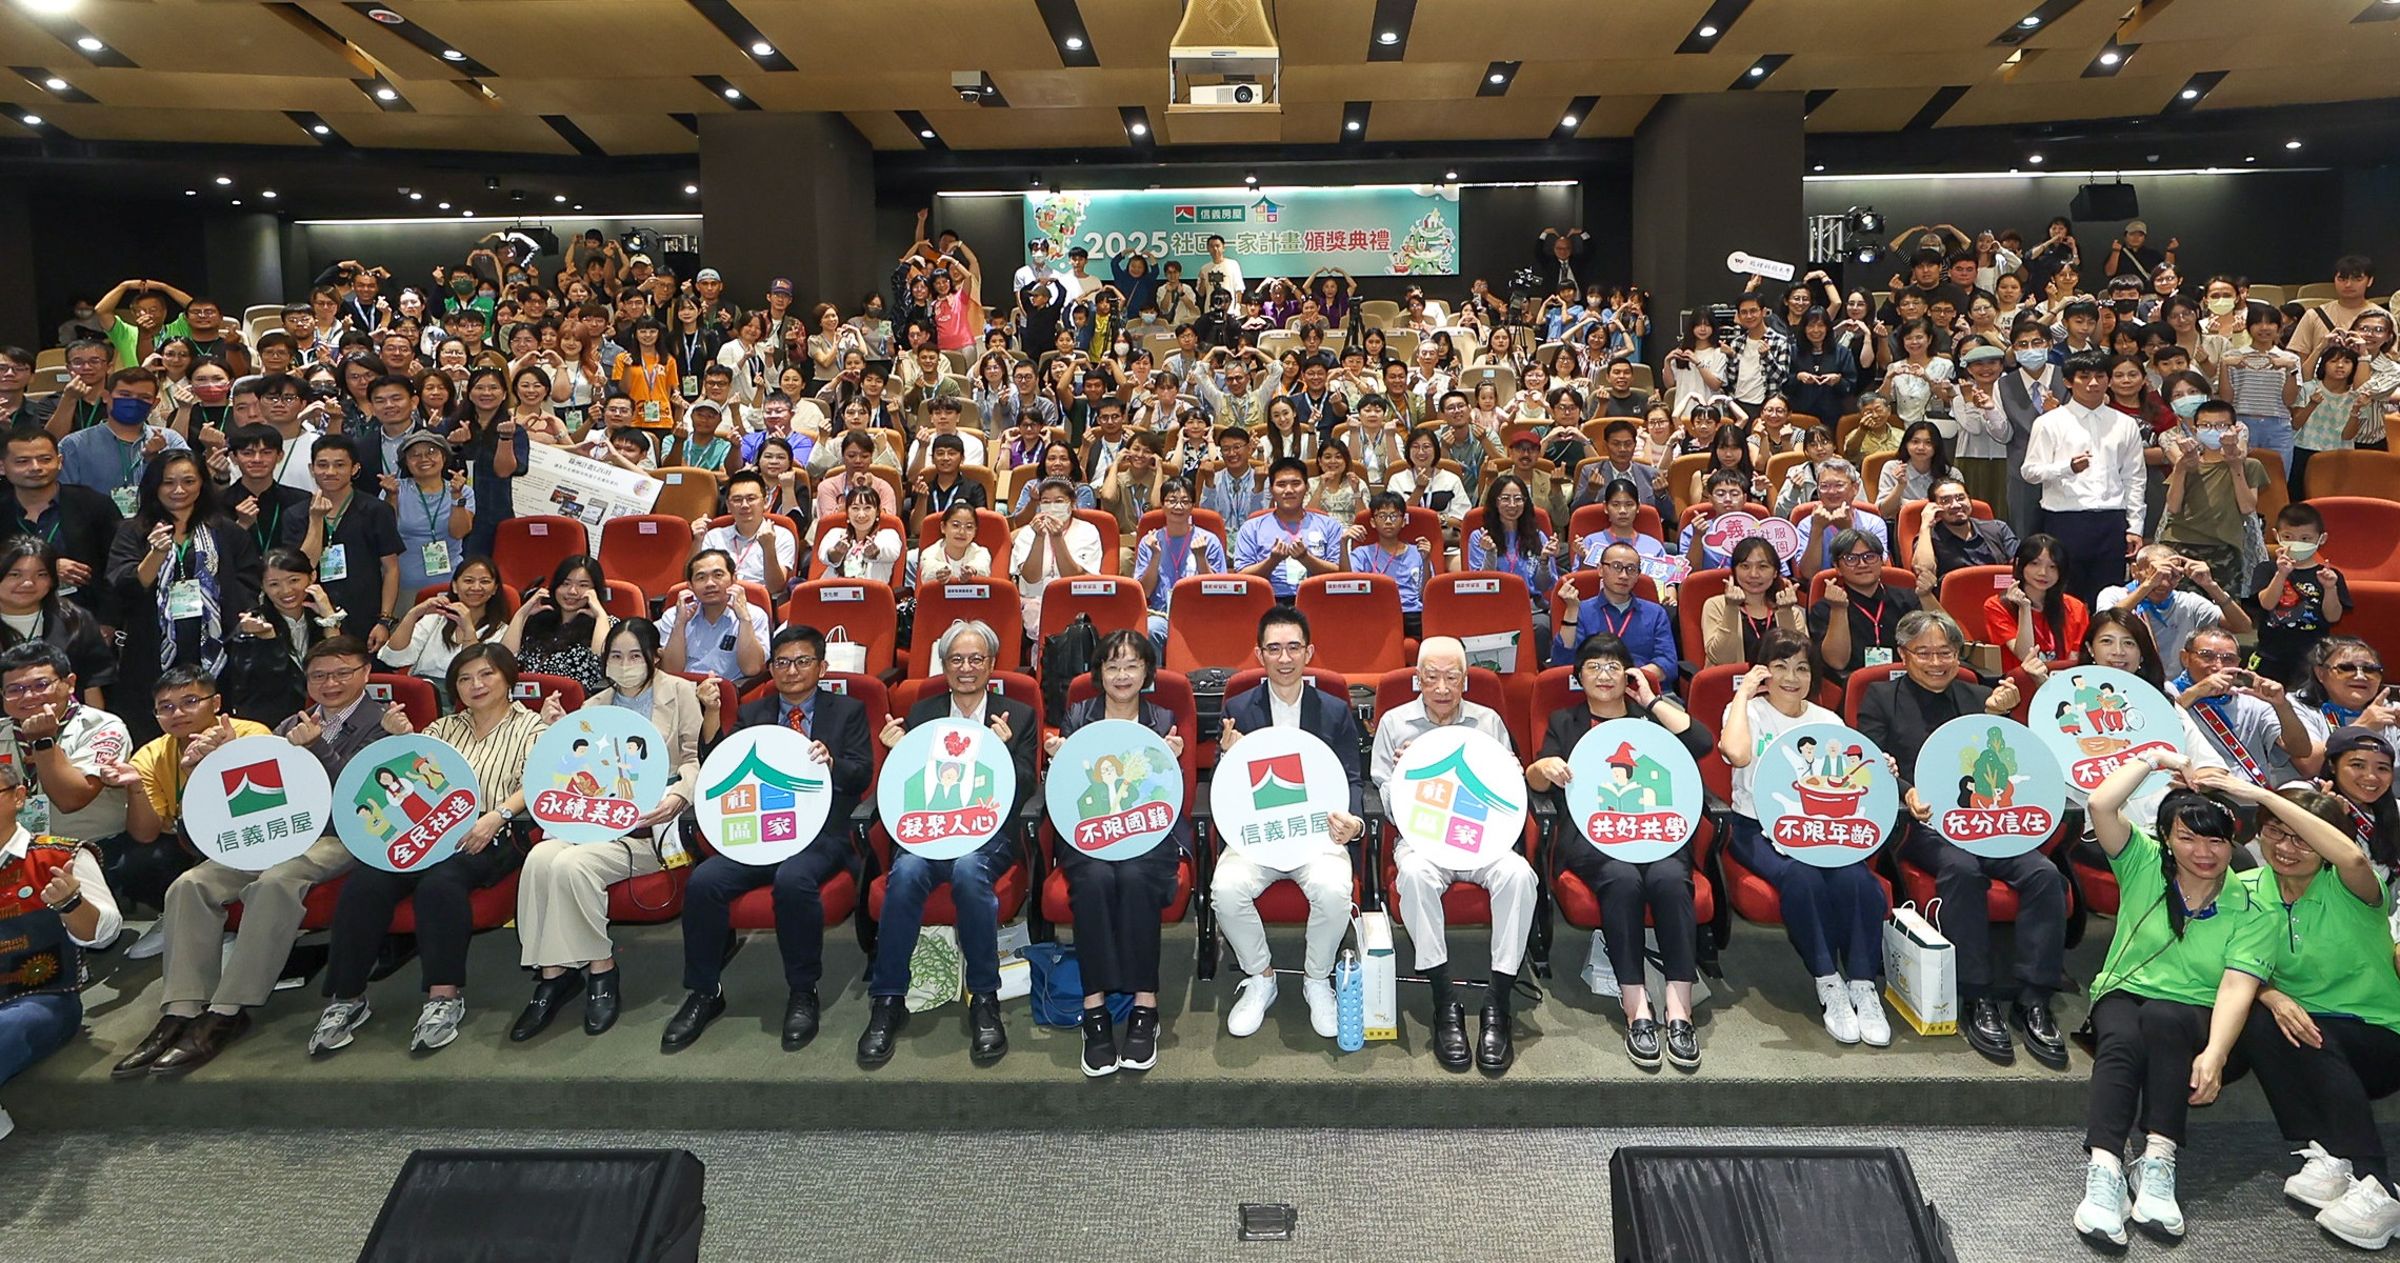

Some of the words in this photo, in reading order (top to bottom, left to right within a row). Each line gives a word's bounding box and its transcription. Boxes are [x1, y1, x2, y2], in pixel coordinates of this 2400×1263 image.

[1200, 208, 1242, 220] 信義房屋
[540, 792, 636, 827] 永續美好
[1080, 805, 1169, 844] 不限國籍
[1945, 811, 2047, 836] 充分信任
[216, 811, 314, 854] 信義房屋
[393, 795, 474, 865] 全民社造
[900, 813, 994, 838] 凝聚人心
[1240, 811, 1330, 846] 信義房屋
[1592, 815, 1687, 842] 共好共學
[1778, 819, 1876, 847] 不限年齡
